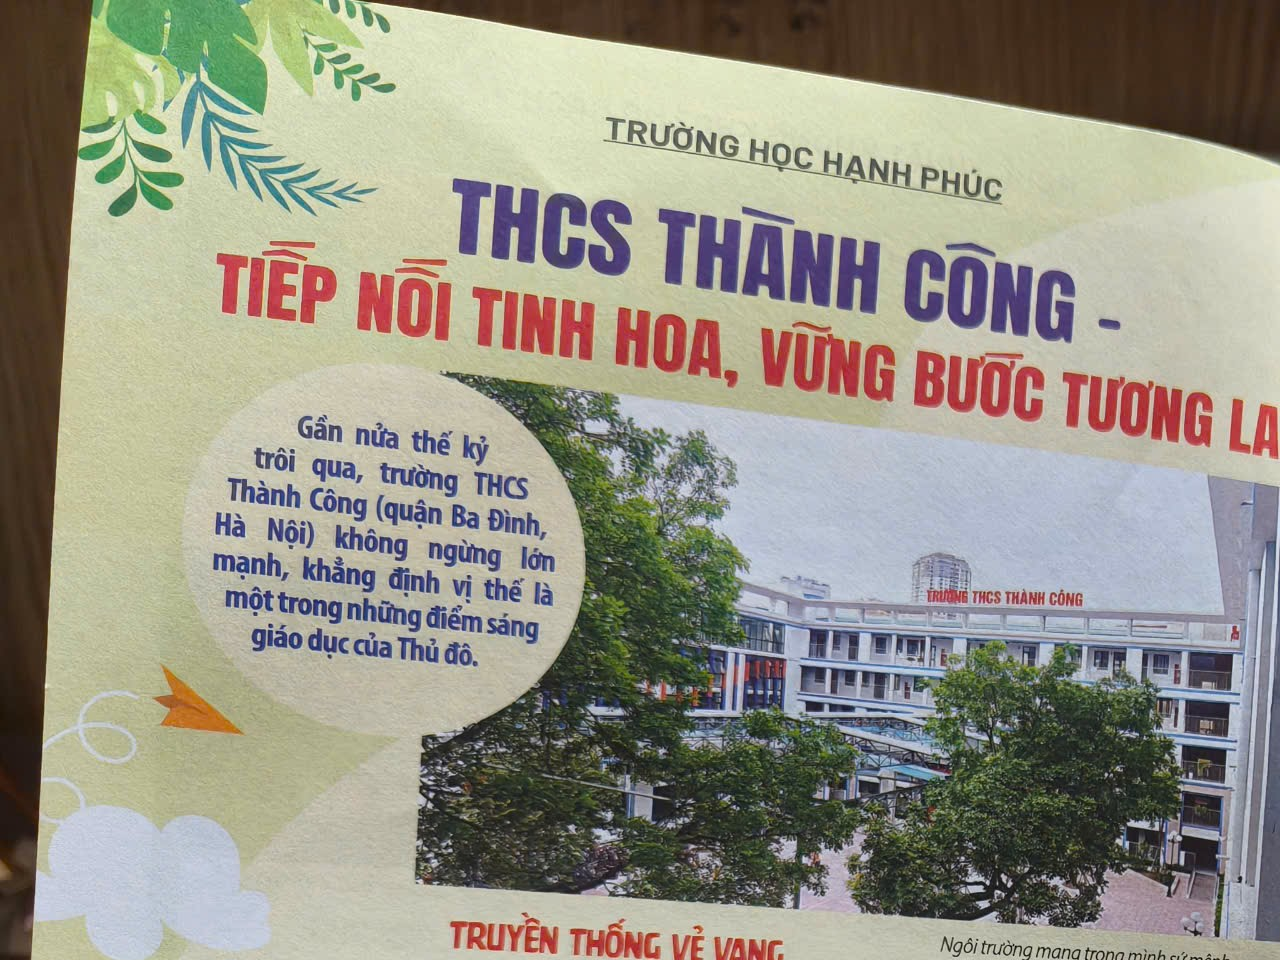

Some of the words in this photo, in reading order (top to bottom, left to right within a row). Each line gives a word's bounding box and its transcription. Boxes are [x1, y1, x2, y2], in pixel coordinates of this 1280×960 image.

[606, 117, 739, 157] TRƯỜNG
[749, 138, 813, 172] HỌC
[823, 150, 911, 184] HẠNH
[921, 167, 1003, 201] PHÚC
[452, 178, 632, 276] THCS
[657, 206, 880, 314] THÀNH
[904, 242, 1076, 343] CÔNG
[1098, 319, 1121, 330] -
[217, 240, 338, 323] TIẾP
[357, 258, 451, 341] NỐI
[473, 287, 594, 361] TINH
[615, 307, 740, 386] HOA,
[761, 321, 897, 402] VỮNG
[914, 350, 1044, 421] BƯỚC
[1063, 371, 1213, 447] TƯƠNG
[297, 414, 343, 443] Gần
[355, 422, 399, 450] nửa
[411, 429, 453, 456] thế
[462, 434, 489, 466] kỷ
[254, 447, 295, 472] trôi
[312, 458, 363, 484] qua,
[379, 462, 458, 498] trường
[474, 471, 528, 500] THCS
[227, 477, 301, 509] Thành
[309, 487, 368, 522] Công
[376, 494, 442, 529] (quận
[451, 504, 480, 529] Ba
[487, 508, 547, 541] Đình,
[215, 512, 246, 538] Hà
[267, 517, 314, 550] Nội)
[335, 524, 408, 562] không
[429, 539, 502, 572] ngừng
[521, 546, 555, 572] lớn
[213, 552, 289, 581] mạnh,
[302, 556, 376, 593] khẳng
[388, 566, 440, 597] định
[452, 575, 472, 604] vị
[484, 577, 525, 603] thế
[534, 581, 553, 606] là
[972, 590, 1000, 605] THCS
[1005, 588, 1045, 606] THÀNH
[225, 586, 274, 616] một
[277, 592, 343, 624] trong
[347, 597, 422, 633] những
[426, 605, 483, 633] điểm
[486, 613, 539, 644] sáng
[450, 912, 559, 954] TRUYỀN
[570, 918, 661, 960] THỐNG
[940, 936, 979, 957] Ngôi
